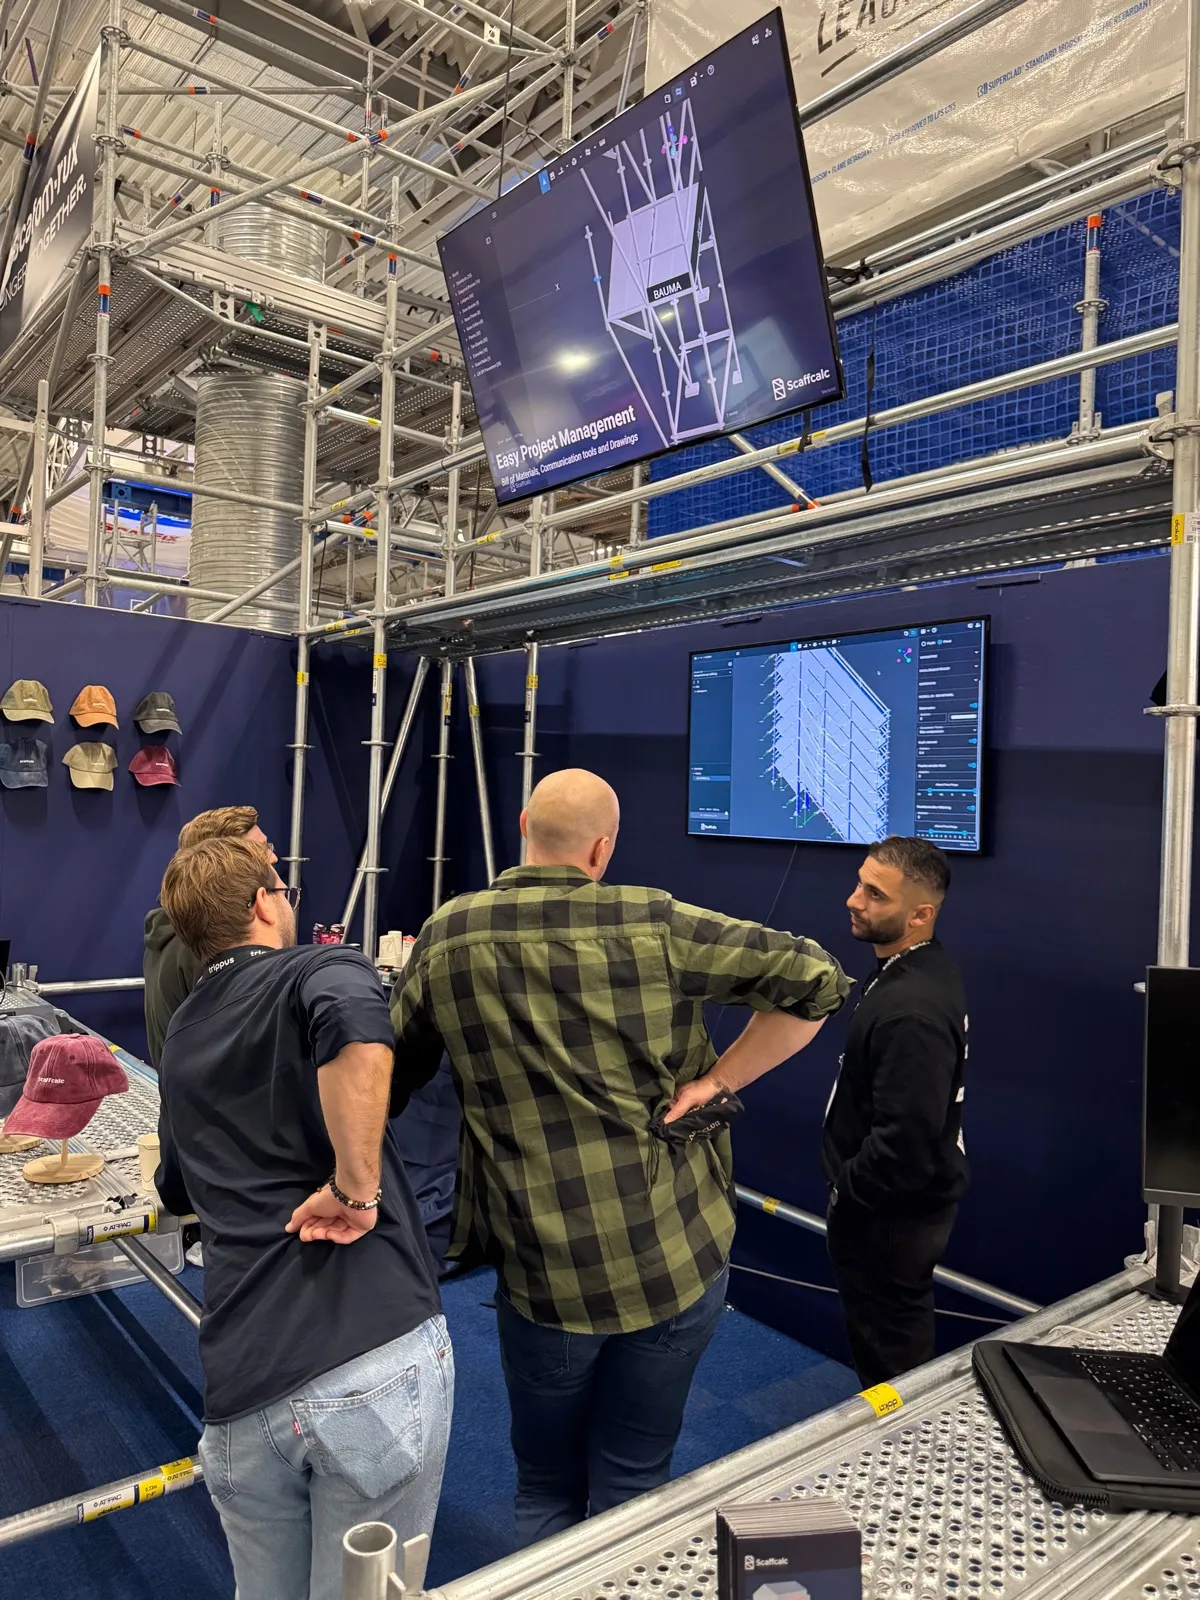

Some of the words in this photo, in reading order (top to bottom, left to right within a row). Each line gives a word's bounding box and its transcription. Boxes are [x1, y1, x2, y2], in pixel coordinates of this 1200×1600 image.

[1025, 48, 1057, 71] STANDARD
[653, 281, 682, 299] BAUMA
[787, 369, 831, 391] Scaffcalc
[496, 450, 519, 469] Easy
[520, 435, 558, 462] Project
[558, 405, 636, 446] Management
[501, 476, 511, 487] Bill
[510, 474, 515, 485] of
[515, 467, 540, 483] Materials,
[540, 453, 582, 474] Communication
[582, 447, 597, 459] tools
[597, 442, 609, 454] and
[609, 433, 639, 451] Drawings
[208, 957, 235, 974] trippus
[756, 1557, 789, 1567] Scaffcalc
